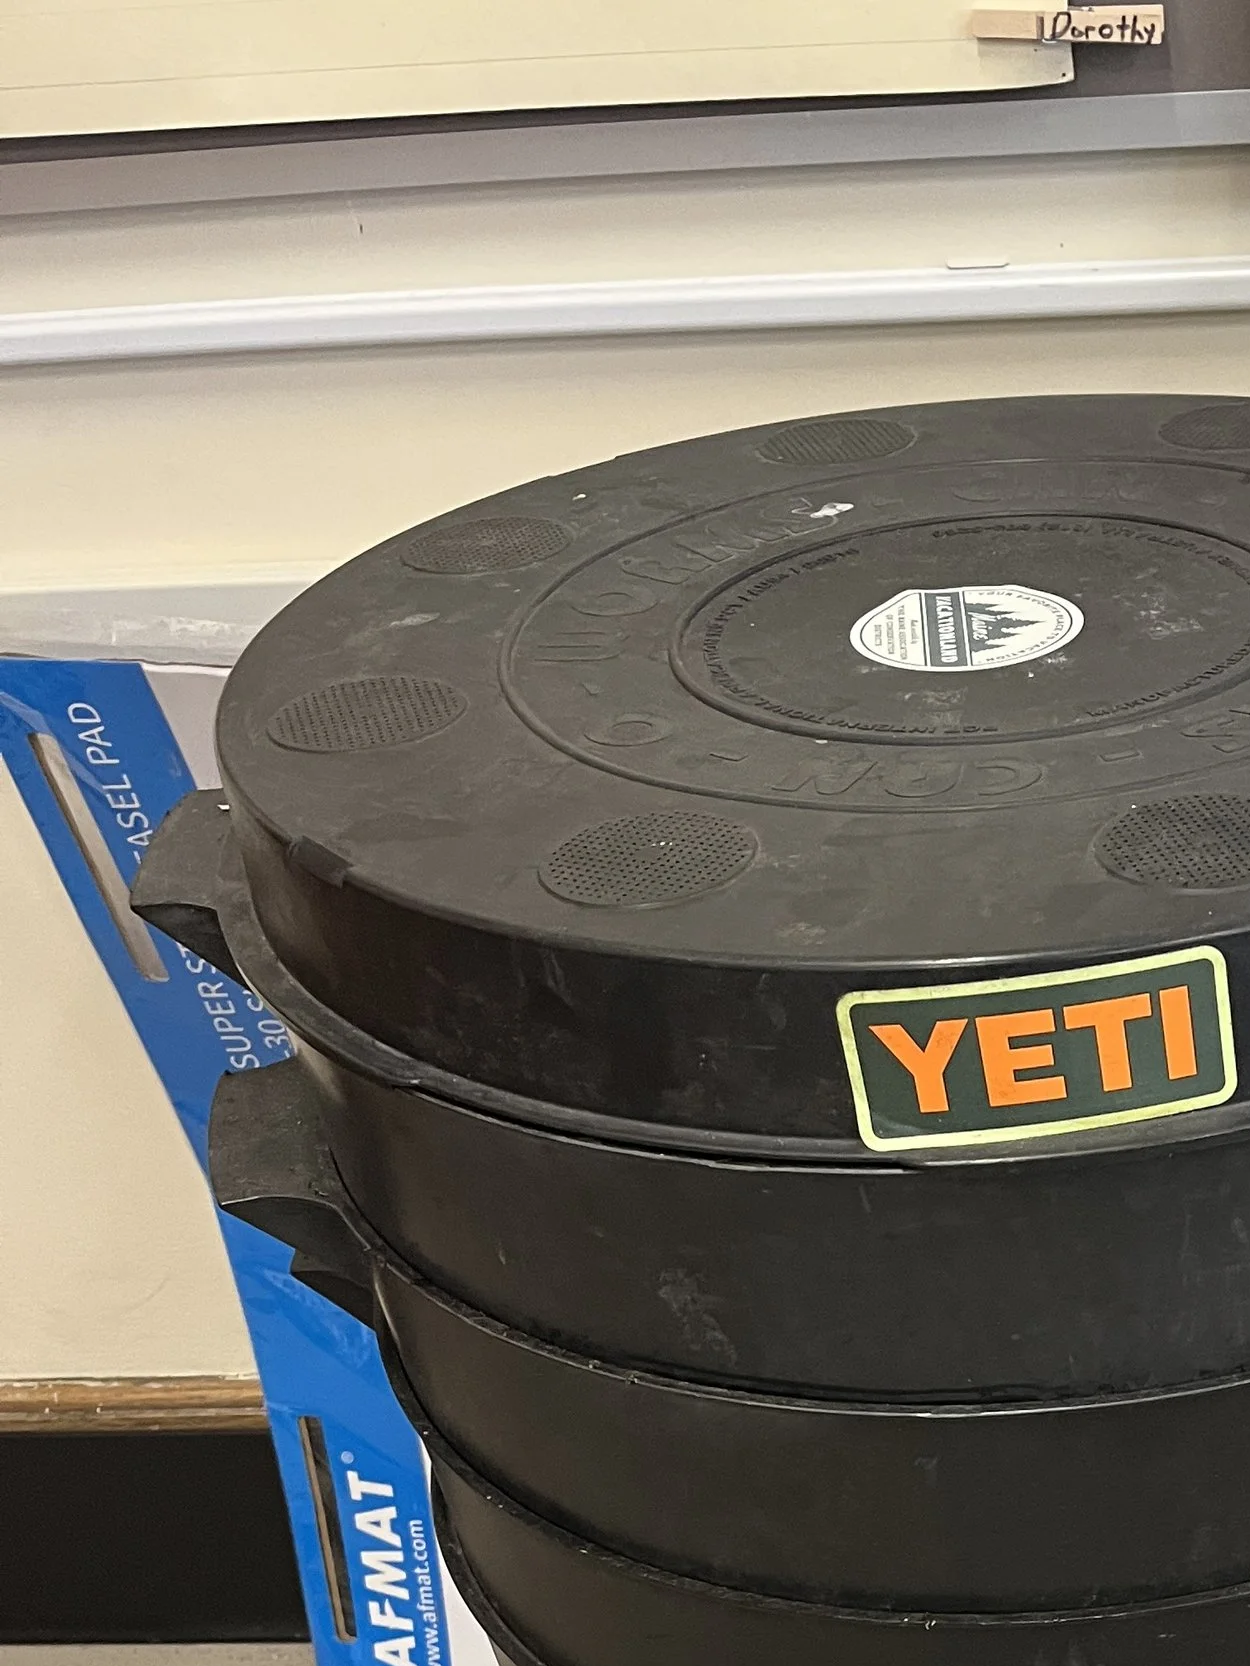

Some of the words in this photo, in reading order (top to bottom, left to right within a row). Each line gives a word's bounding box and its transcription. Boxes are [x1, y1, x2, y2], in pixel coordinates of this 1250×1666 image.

[1052, 12, 1156, 45] Dorothy
[935, 595, 959, 663] VACATIONLAND
[967, 612, 1002, 641] Maine
[68, 702, 120, 765] PAD
[197, 981, 261, 1069] SUPER
[868, 984, 1198, 1114] YETI
